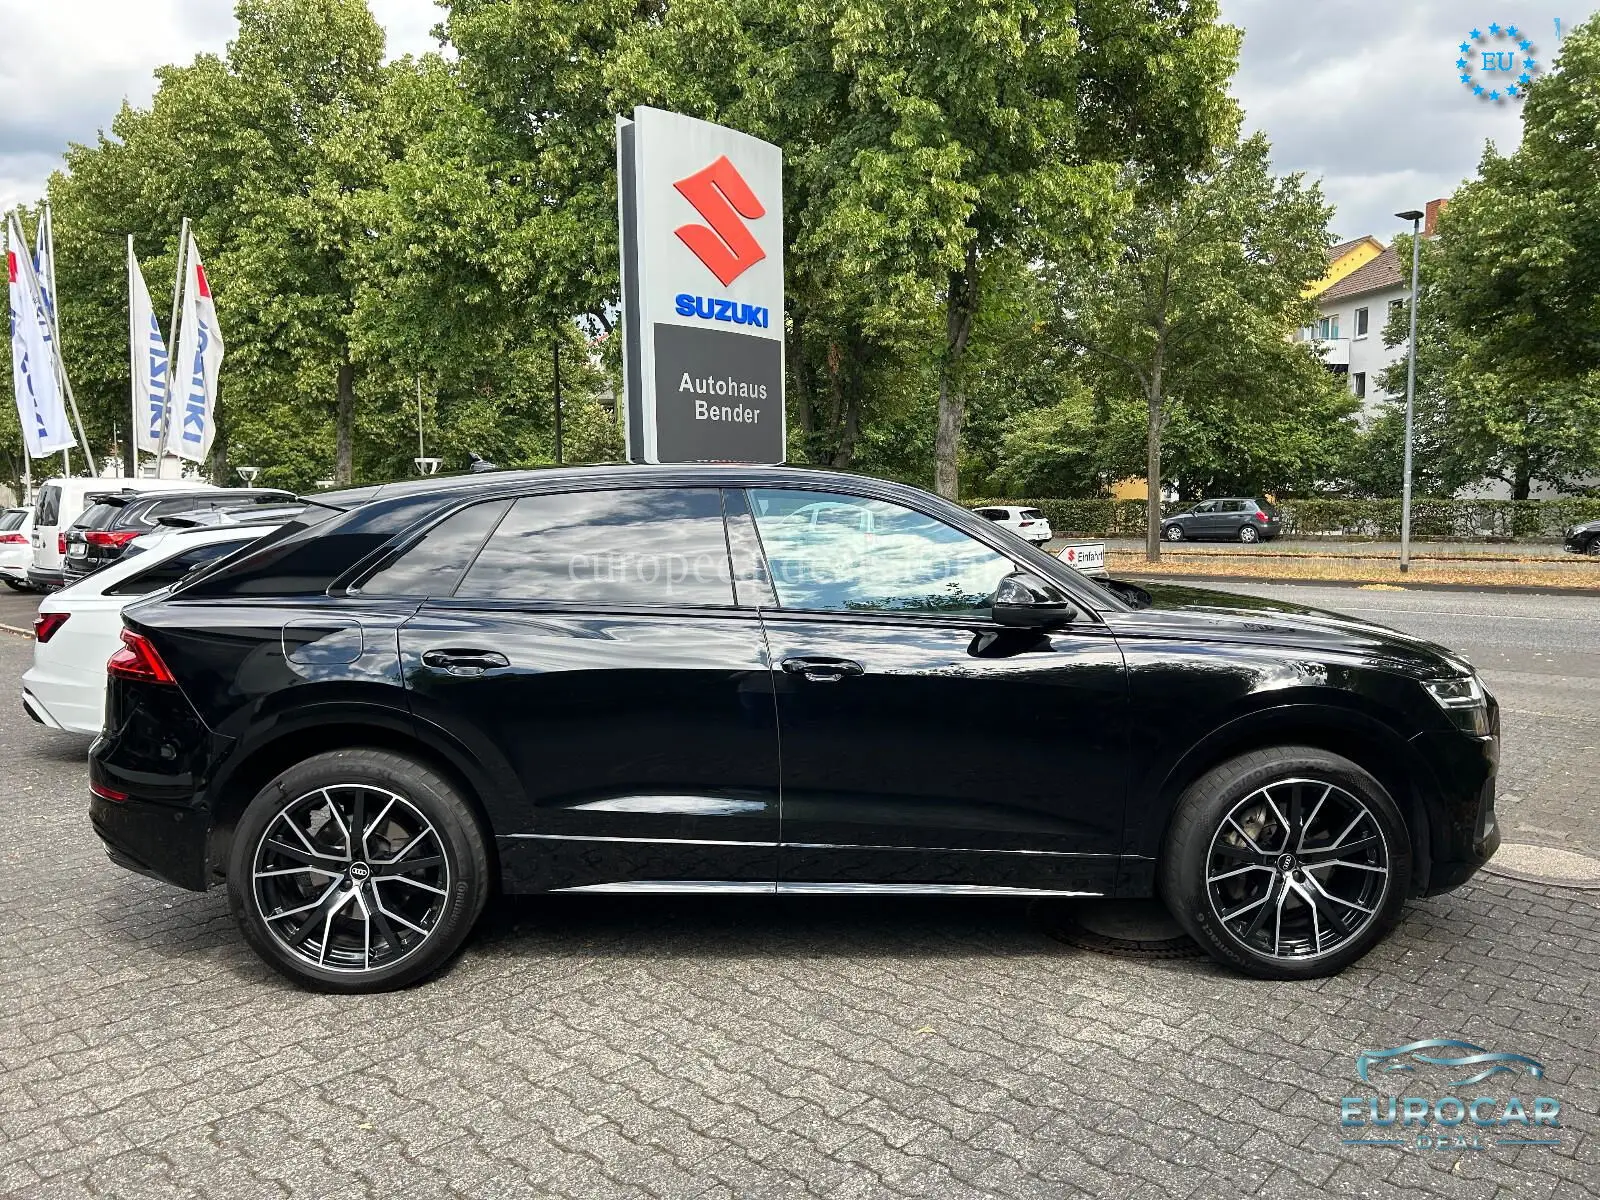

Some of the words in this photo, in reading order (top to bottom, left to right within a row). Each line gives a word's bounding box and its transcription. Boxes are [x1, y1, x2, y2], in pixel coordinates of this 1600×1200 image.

[675, 293, 769, 329] SUZUKI
[678, 373, 768, 400] Autohaus
[695, 400, 761, 424] Bender
